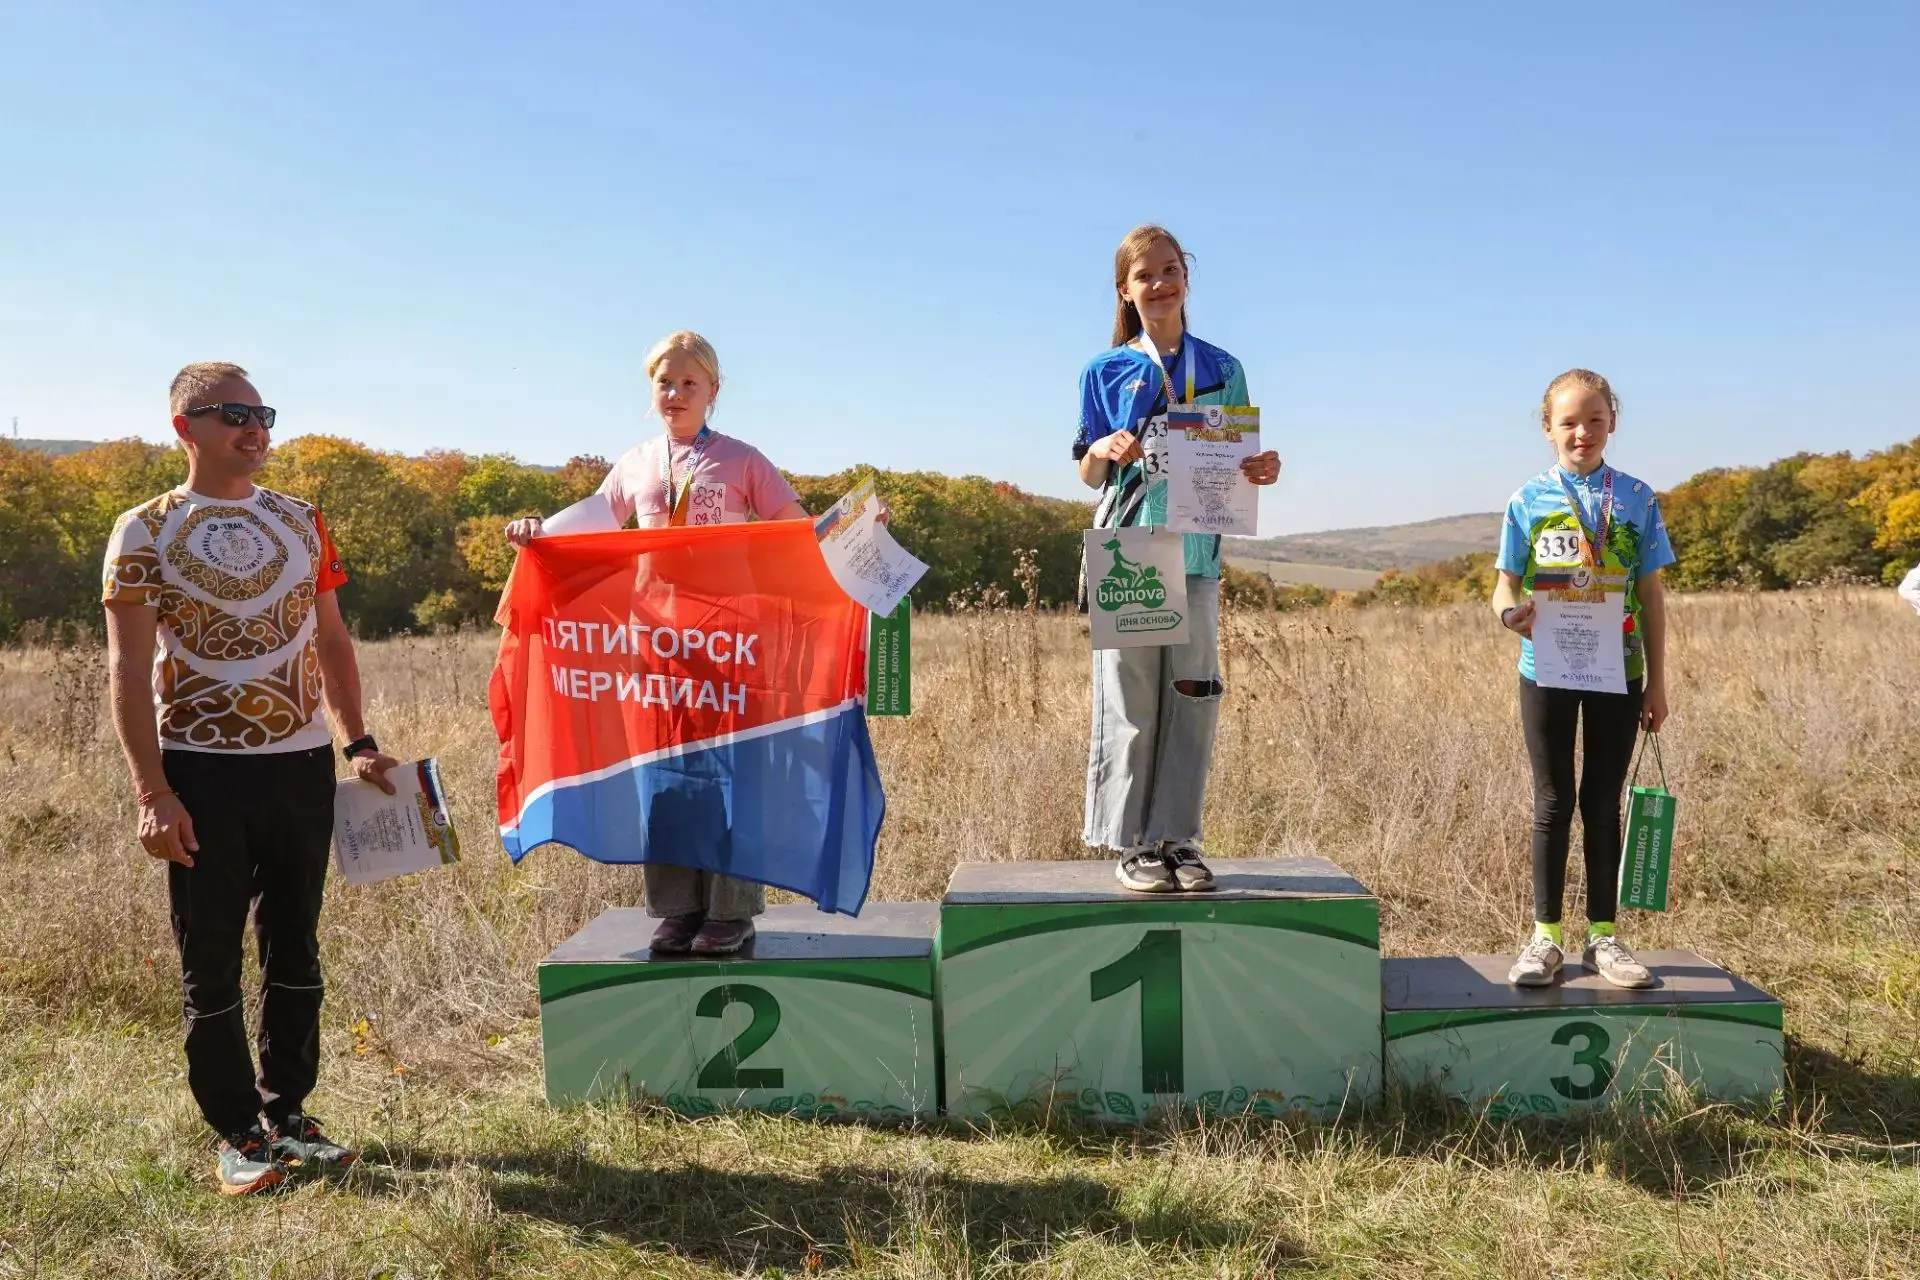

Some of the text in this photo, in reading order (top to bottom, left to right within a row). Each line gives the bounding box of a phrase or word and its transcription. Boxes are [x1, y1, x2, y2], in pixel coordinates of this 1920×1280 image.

[1540, 536, 1579, 557] 339
[1098, 586, 1165, 603] bionova
[541, 616, 759, 667] ПЯТИГОРСК
[1119, 615, 1176, 627] ДНЯ ОСНОВА
[551, 663, 746, 715] МЕРИДИАН
[695, 983, 784, 1089] 2
[1090, 929, 1184, 1094] 1
[1550, 1021, 1614, 1100] 3
